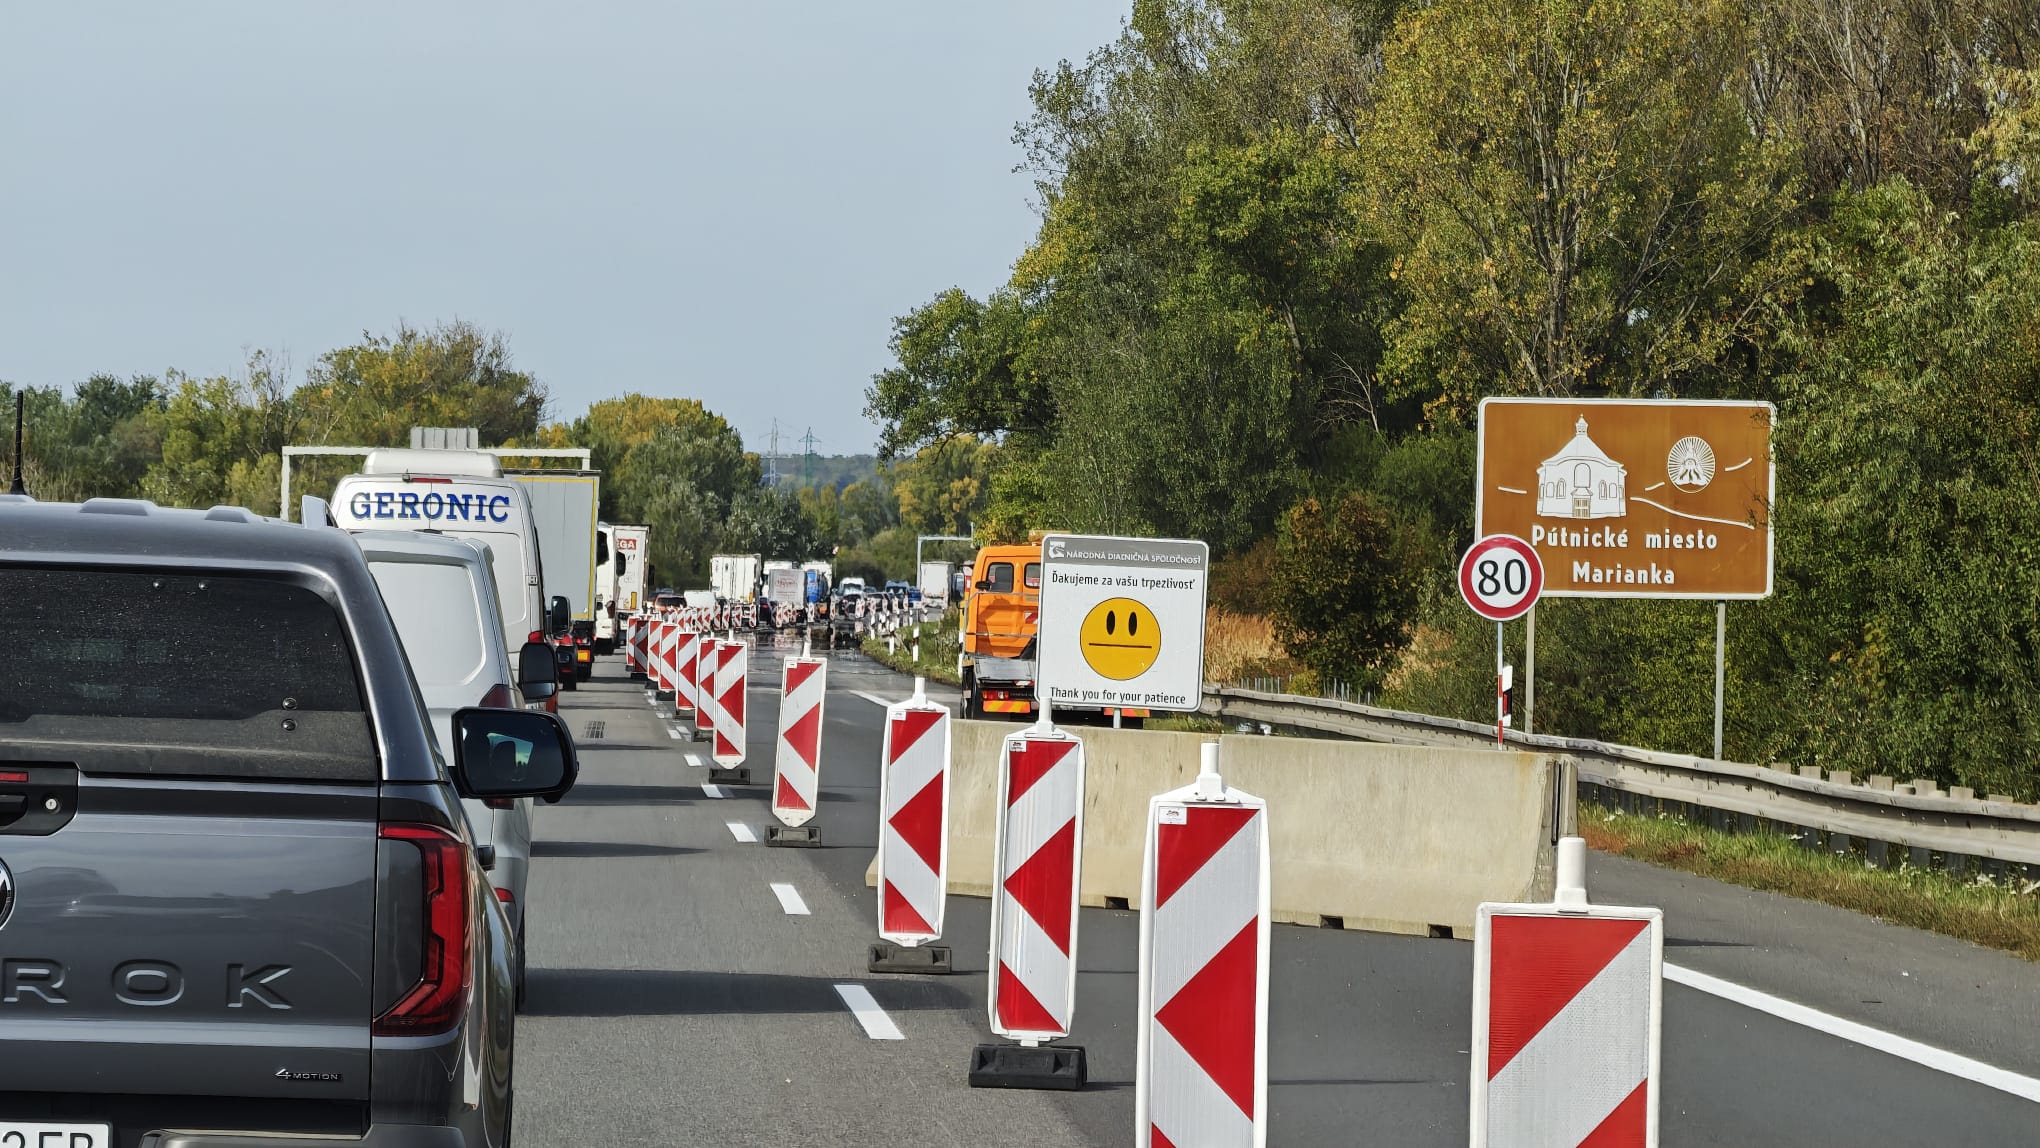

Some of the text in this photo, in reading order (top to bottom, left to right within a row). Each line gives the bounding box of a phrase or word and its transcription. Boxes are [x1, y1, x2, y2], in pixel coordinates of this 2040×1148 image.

[350, 492, 509, 522] GERONIC
[1532, 525, 1718, 549] Pútnické miesto
[1052, 571, 1196, 590] Ďakujeme za vašu trpezlivosť
[1478, 558, 1526, 596] 80
[1572, 561, 1675, 585] Marianka
[1050, 687, 1186, 704] Thank you for your patience
[2, 958, 293, 1010] ROK
[274, 1068, 339, 1080] 4MOTION
